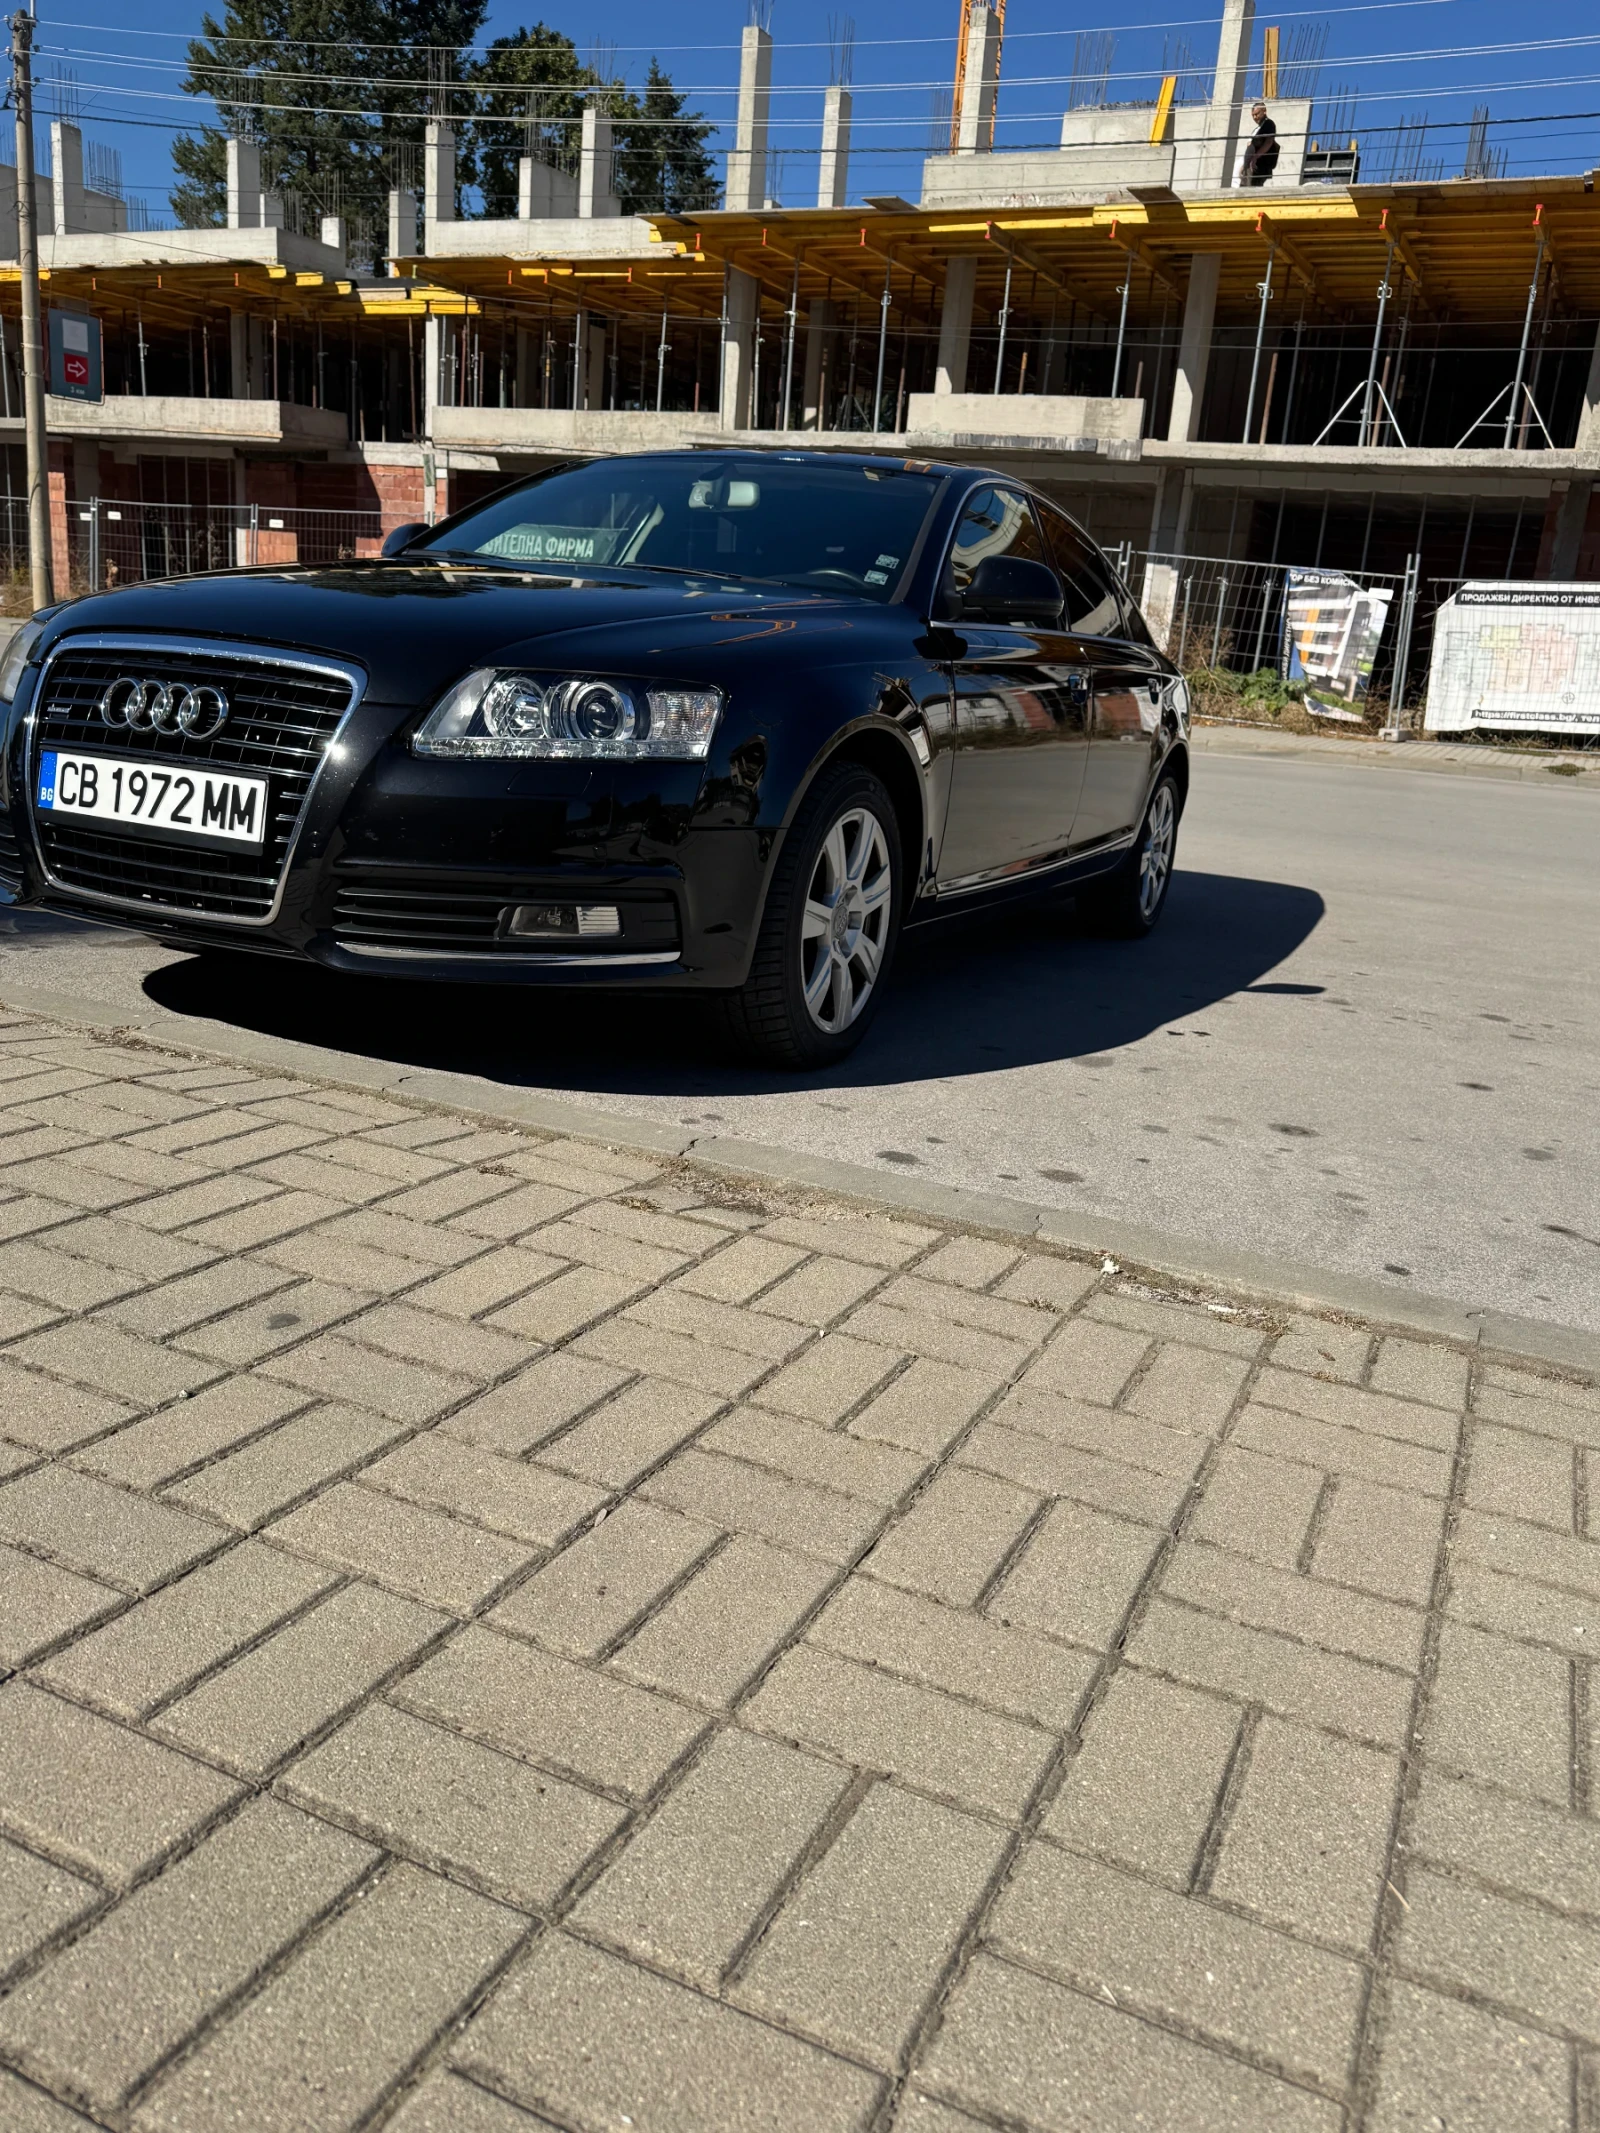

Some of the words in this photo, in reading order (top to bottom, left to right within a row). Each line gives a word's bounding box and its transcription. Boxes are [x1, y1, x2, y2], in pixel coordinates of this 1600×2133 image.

[545, 536, 593, 558] ФИРМА
[1304, 575, 1319, 583] БЕЗ
[1461, 593, 1510, 602] ПРОДАЖБИ
[1511, 594, 1559, 604] ДИРЕКТНО
[1561, 595, 1574, 603] ОТ
[1575, 595, 1600, 604] ИНВЕ
[1475, 710, 1579, 722] https://firstclass.bg/,
[41, 788, 53, 801] BG
[59, 761, 98, 808] CB
[112, 767, 195, 825] 1972
[201, 780, 258, 834] MM
